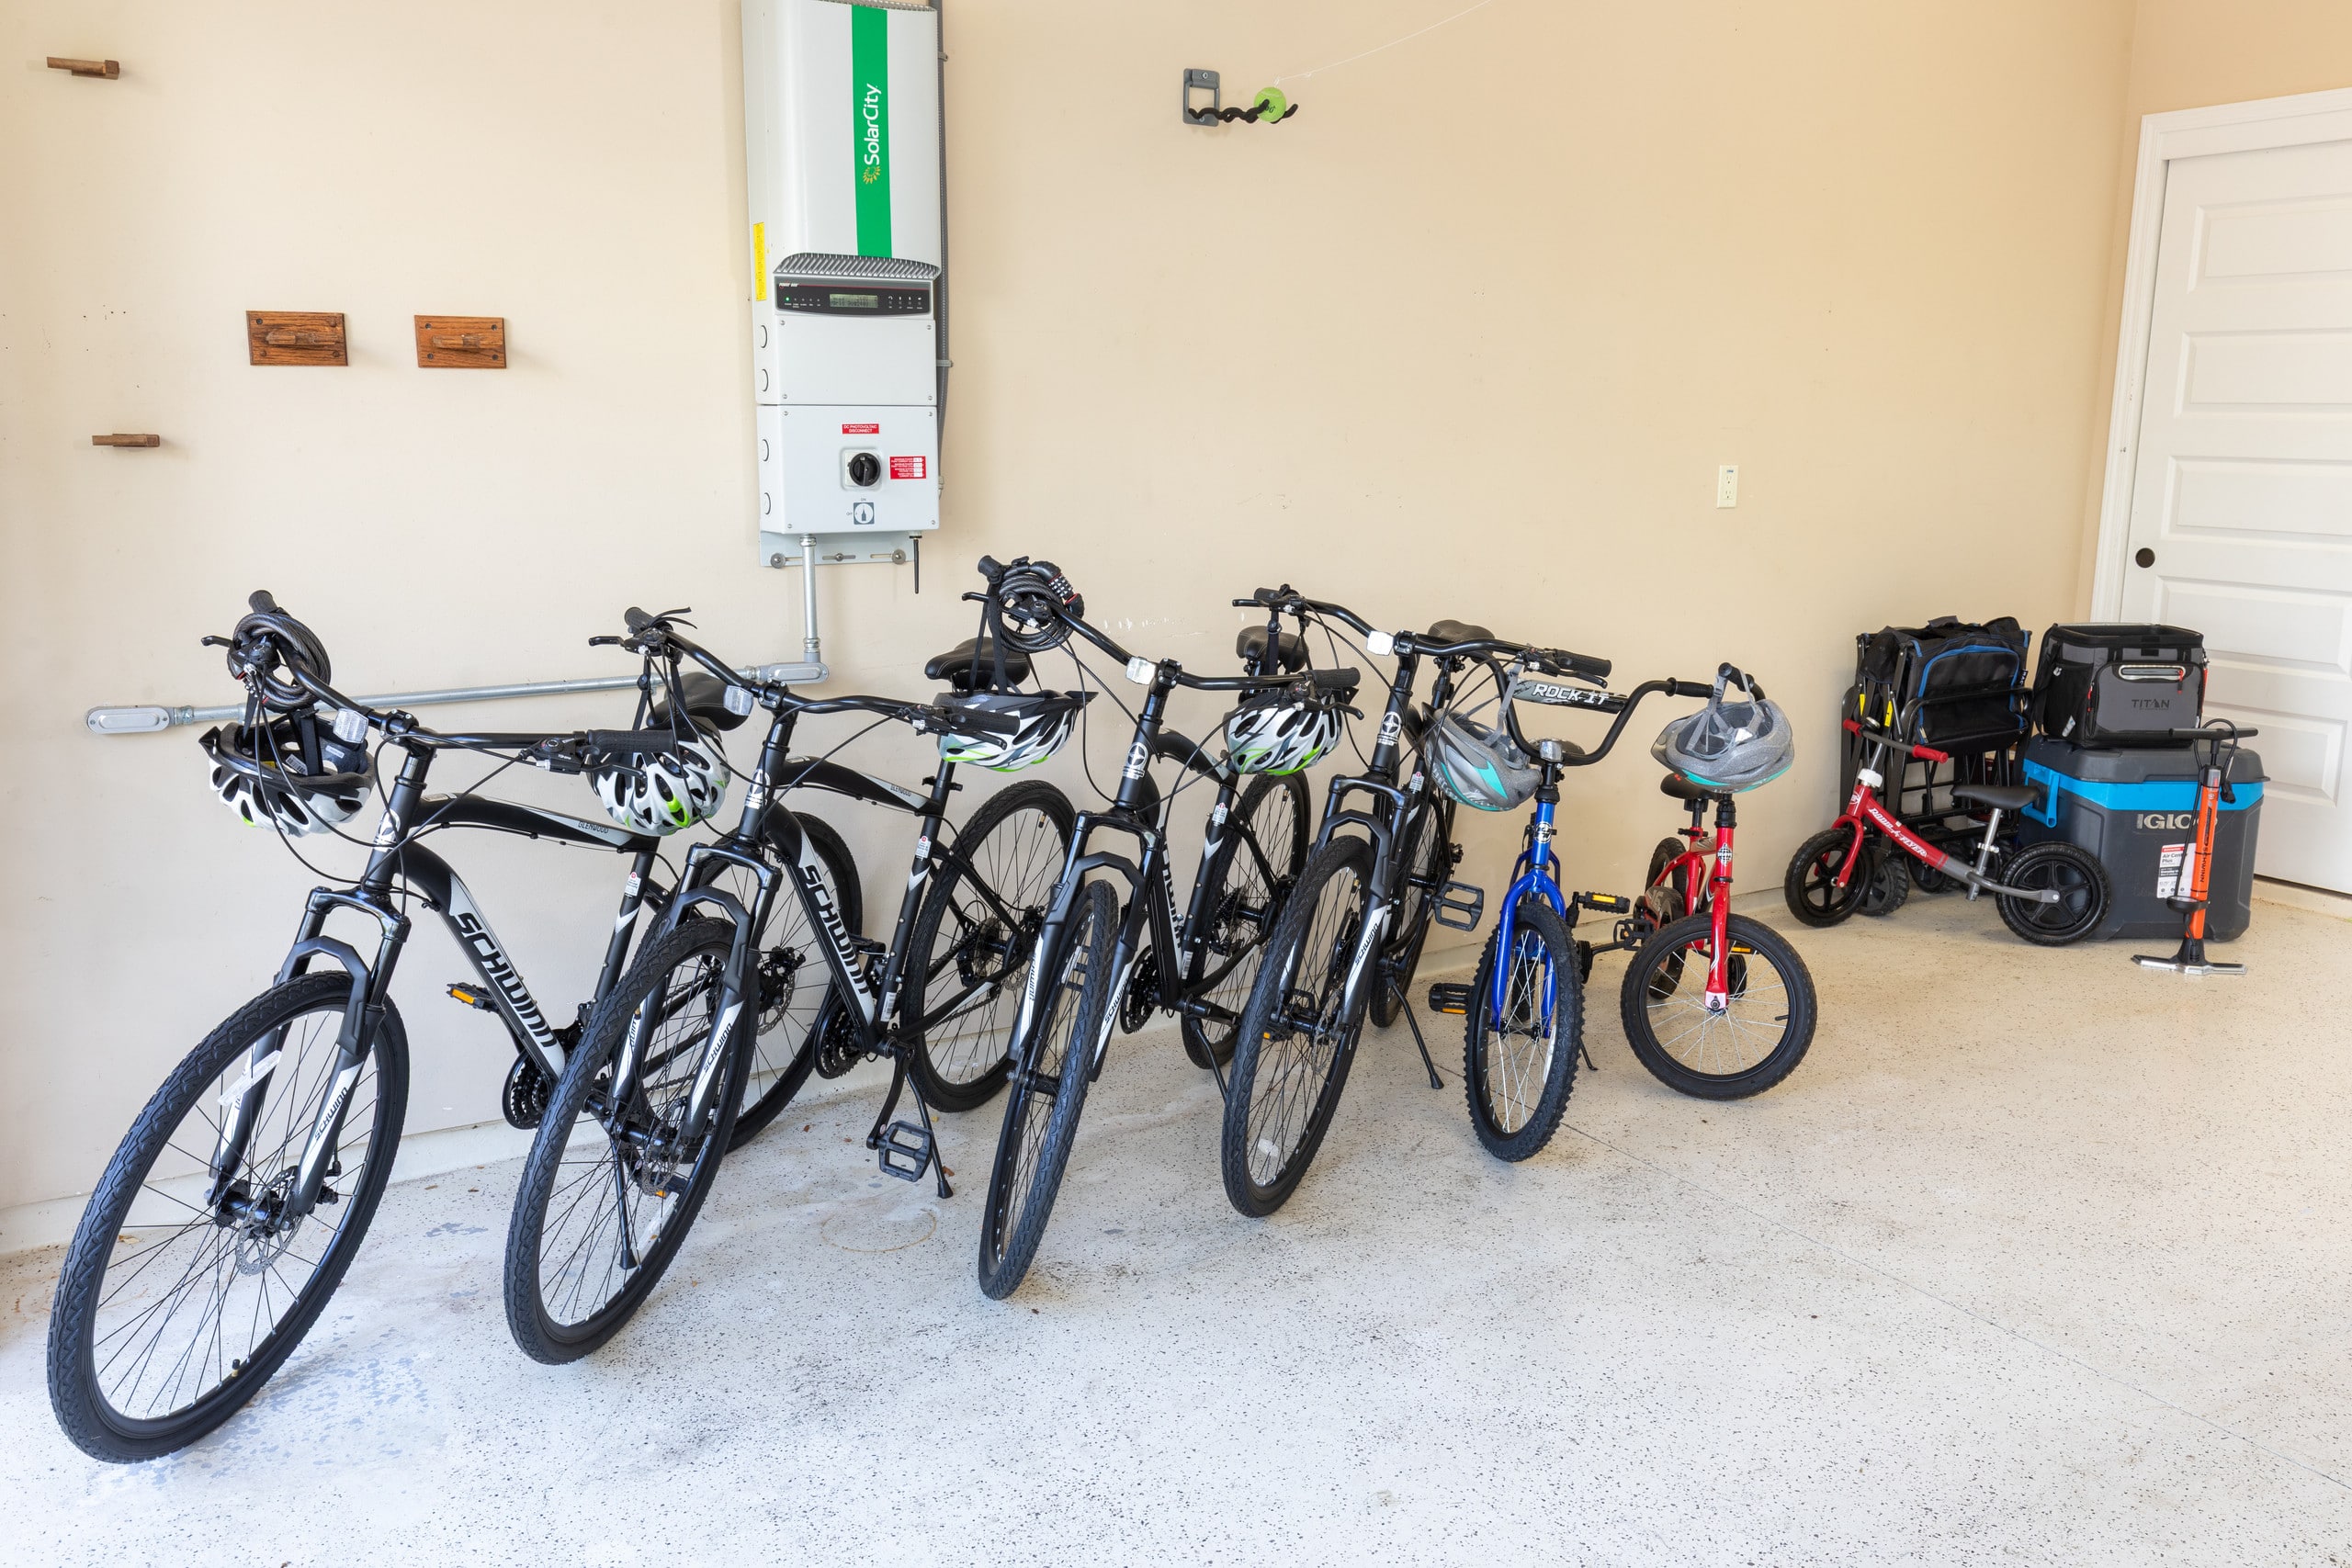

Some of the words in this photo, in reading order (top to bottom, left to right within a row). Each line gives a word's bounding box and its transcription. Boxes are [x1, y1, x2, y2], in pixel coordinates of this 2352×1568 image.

[863, 83, 882, 165] SolarCity
[2131, 699, 2170, 708] TITAN
[578, 820, 609, 834] GLENWOOD
[2136, 813, 2218, 829] IGLO
[805, 864, 869, 995] SCHWINN
[1355, 923, 1379, 964] SCHWINN
[458, 912, 559, 1048] SCHWINN
[704, 1022, 732, 1073] SCHWINN
[314, 1087, 348, 1141] SCHWINN
